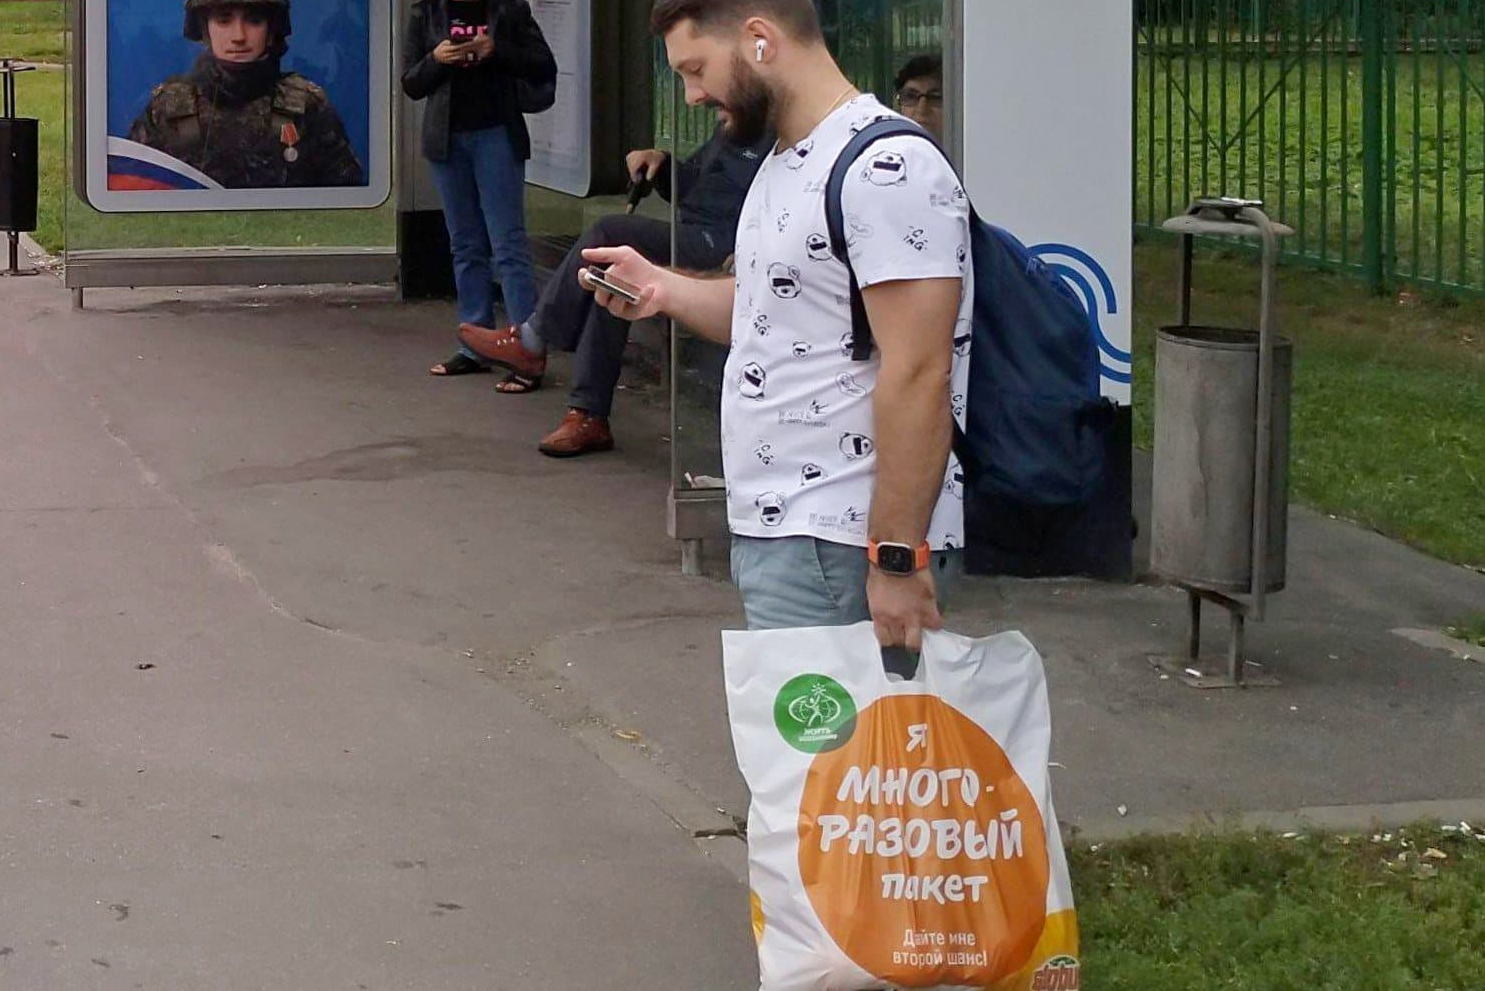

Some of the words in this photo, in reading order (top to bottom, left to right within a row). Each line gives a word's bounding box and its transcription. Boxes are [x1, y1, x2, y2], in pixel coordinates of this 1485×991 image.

[906, 723, 928, 752] Я
[817, 808, 1023, 860] РАЗОВЫЙ
[903, 929, 946, 948] Дайте
[949, 932, 977, 947] мне
[892, 949, 944, 969] второй
[947, 950, 988, 967] шанс!
